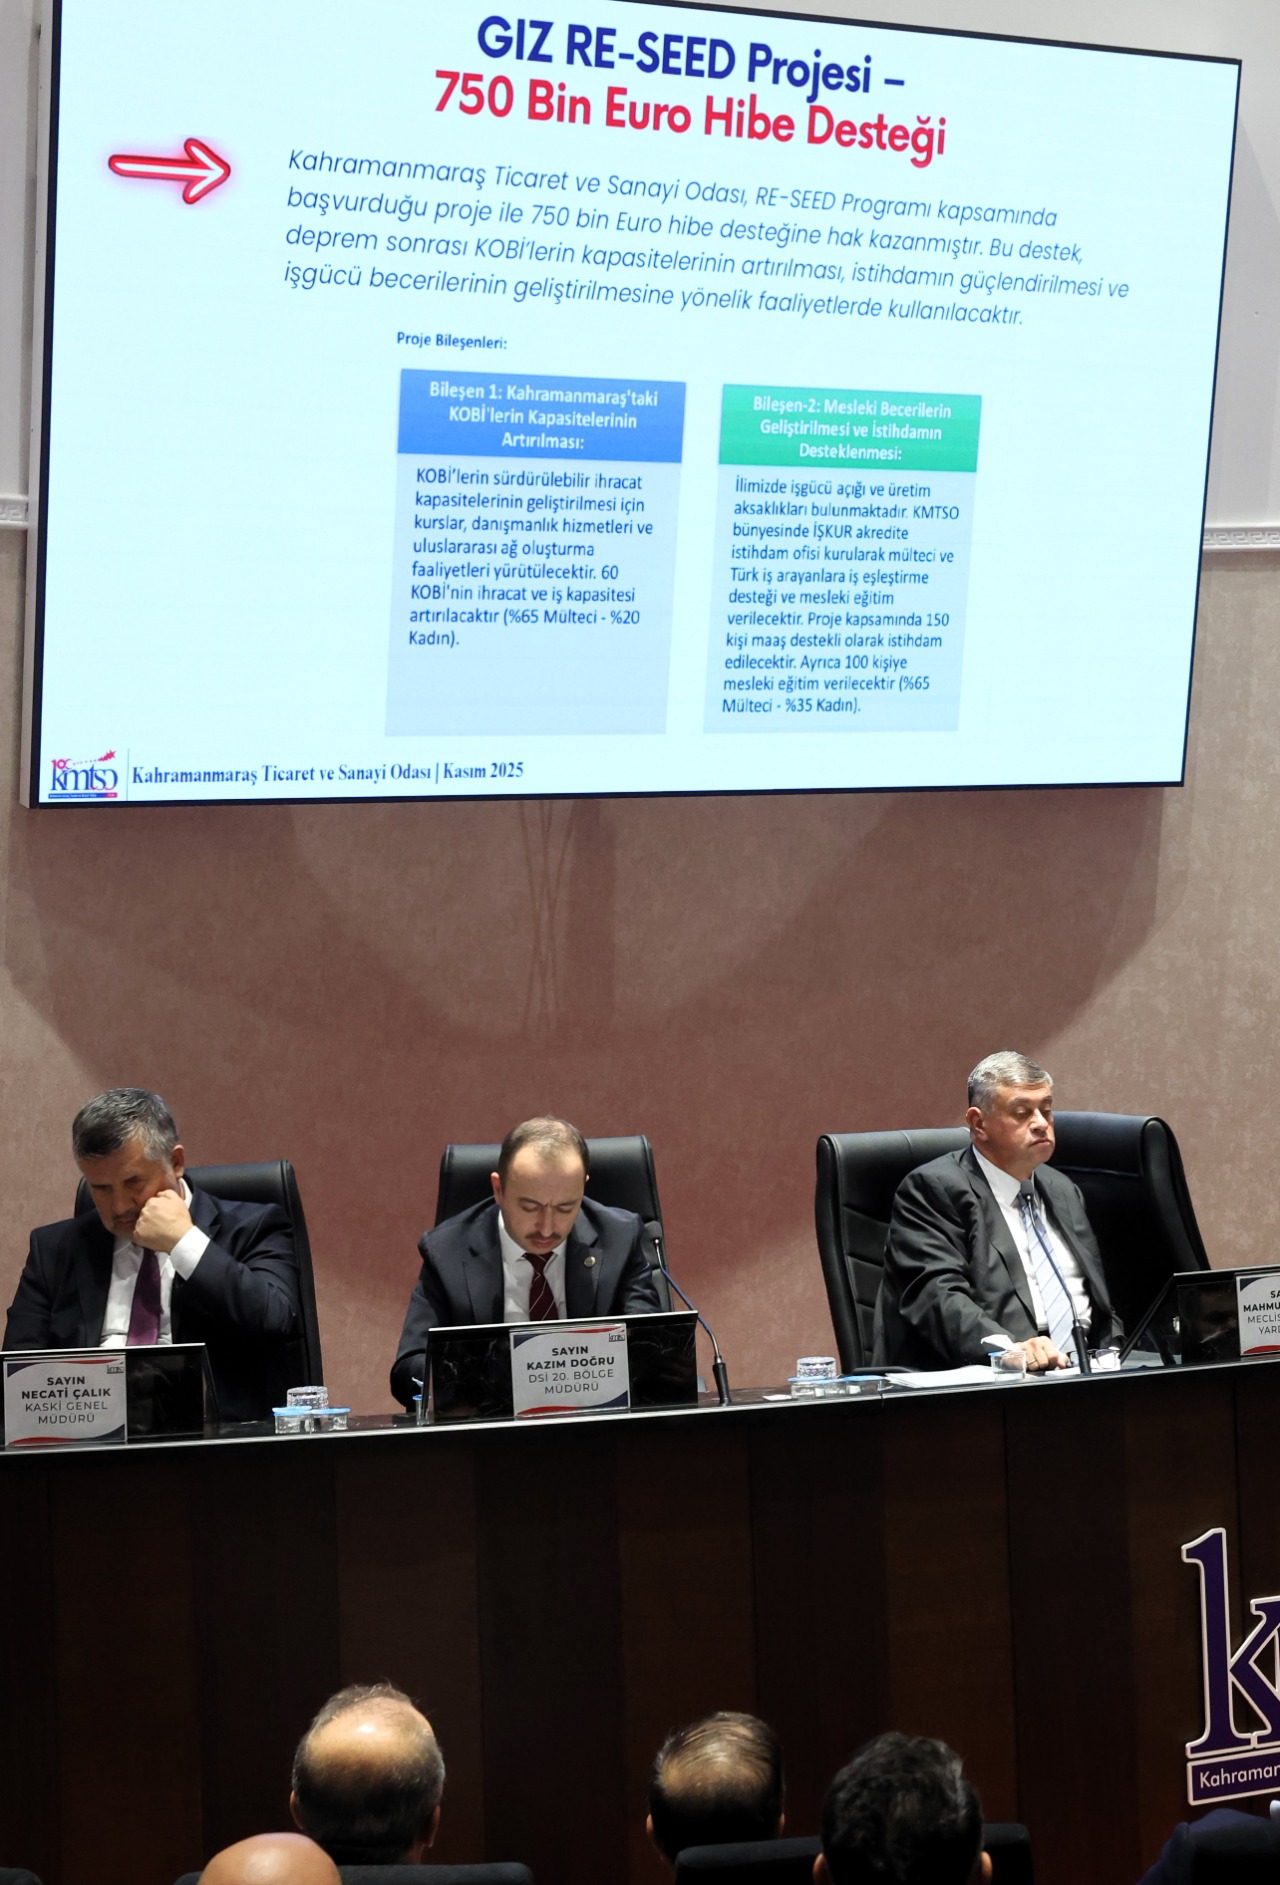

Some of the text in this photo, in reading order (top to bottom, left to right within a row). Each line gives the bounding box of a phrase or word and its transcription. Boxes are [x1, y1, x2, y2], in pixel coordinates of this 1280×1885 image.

[477, 15, 872, 104] GIZ RE-SEED Projesi
[435, 70, 946, 168] 750 Bin Euro Hibe Desteği
[288, 149, 1057, 227] Kahramanmaraş Ticaret ve Sanayi Odası, RE-SEED Programı kapsamında
[287, 186, 1082, 264] başvurduğu proje ile 750 bin Euro hibe desteğine hak kazanmıştır. Bu destek,
[286, 224, 378, 253] deprem
[386, 235, 468, 256] sonrası
[581, 244, 735, 273] kapasitelerinin
[741, 258, 844, 282] artırılması,
[852, 261, 954, 287] istihdamın
[960, 270, 1103, 296] güçlendirilmesi
[1109, 283, 1129, 298] ve
[284, 260, 1022, 325] işgücü becerilerinin geliştirilmesine yönelik faaliyetlerde kullanılacaktır.
[397, 331, 507, 351] Proje Bileşenleri:
[430, 381, 485, 401] Bileşen
[528, 410, 637, 428] Kapasitelerinin
[824, 399, 877, 419] Mesleki
[881, 401, 951, 419] Becerilerin
[760, 419, 942, 441] Geliştirilmesi ve İstihdamın
[494, 470, 590, 488] sürdürülebilir
[595, 473, 642, 490] ihracat
[736, 476, 931, 499] İlimizde işgücü açığı ve üretim
[415, 491, 644, 516] kapasitelerinin geliştirilmesi için
[734, 500, 807, 516] aksaklıkları
[913, 505, 959, 520] KMTSO
[472, 515, 558, 535] danışmanlık
[563, 518, 633, 534] hizmetleri
[637, 523, 653, 535] ve
[733, 522, 909, 542] bünyesinde İŞKUR akredite
[413, 537, 594, 559] uluslararası ağ oluşturma
[412, 560, 490, 580] faaliyetleri
[601, 565, 619, 580] 60
[730, 567, 929, 587] Türk iş arayanlara iş eşleştirme
[478, 585, 527, 601] ihracat
[531, 590, 548, 601] ve
[552, 586, 563, 605] iş
[567, 586, 635, 604] kapasitesi
[410, 607, 640, 626] artırılacaktır (%65 Mülteci %20
[800, 655, 841, 672] Ayrıca
[845, 655, 869, 669] 100
[873, 655, 907, 673] kişiye
[133, 761, 523, 785] Kahramanmaraş Ticaret ve Sanayi Odası Kasım 2025
[552, 1346, 588, 1356] SAYIN
[527, 1356, 614, 1371] KAZIM DOĞRU
[47, 1376, 85, 1386] SAYIN
[528, 1368, 614, 1384] DSİ 20. BÖLGE
[21, 1387, 111, 1400] NECATİ ÇALIK
[544, 1382, 599, 1394] MÜDÜRÜ
[25, 1401, 108, 1412] KASKİ GENEL
[38, 1414, 95, 1425] MÜDÜRÜ
